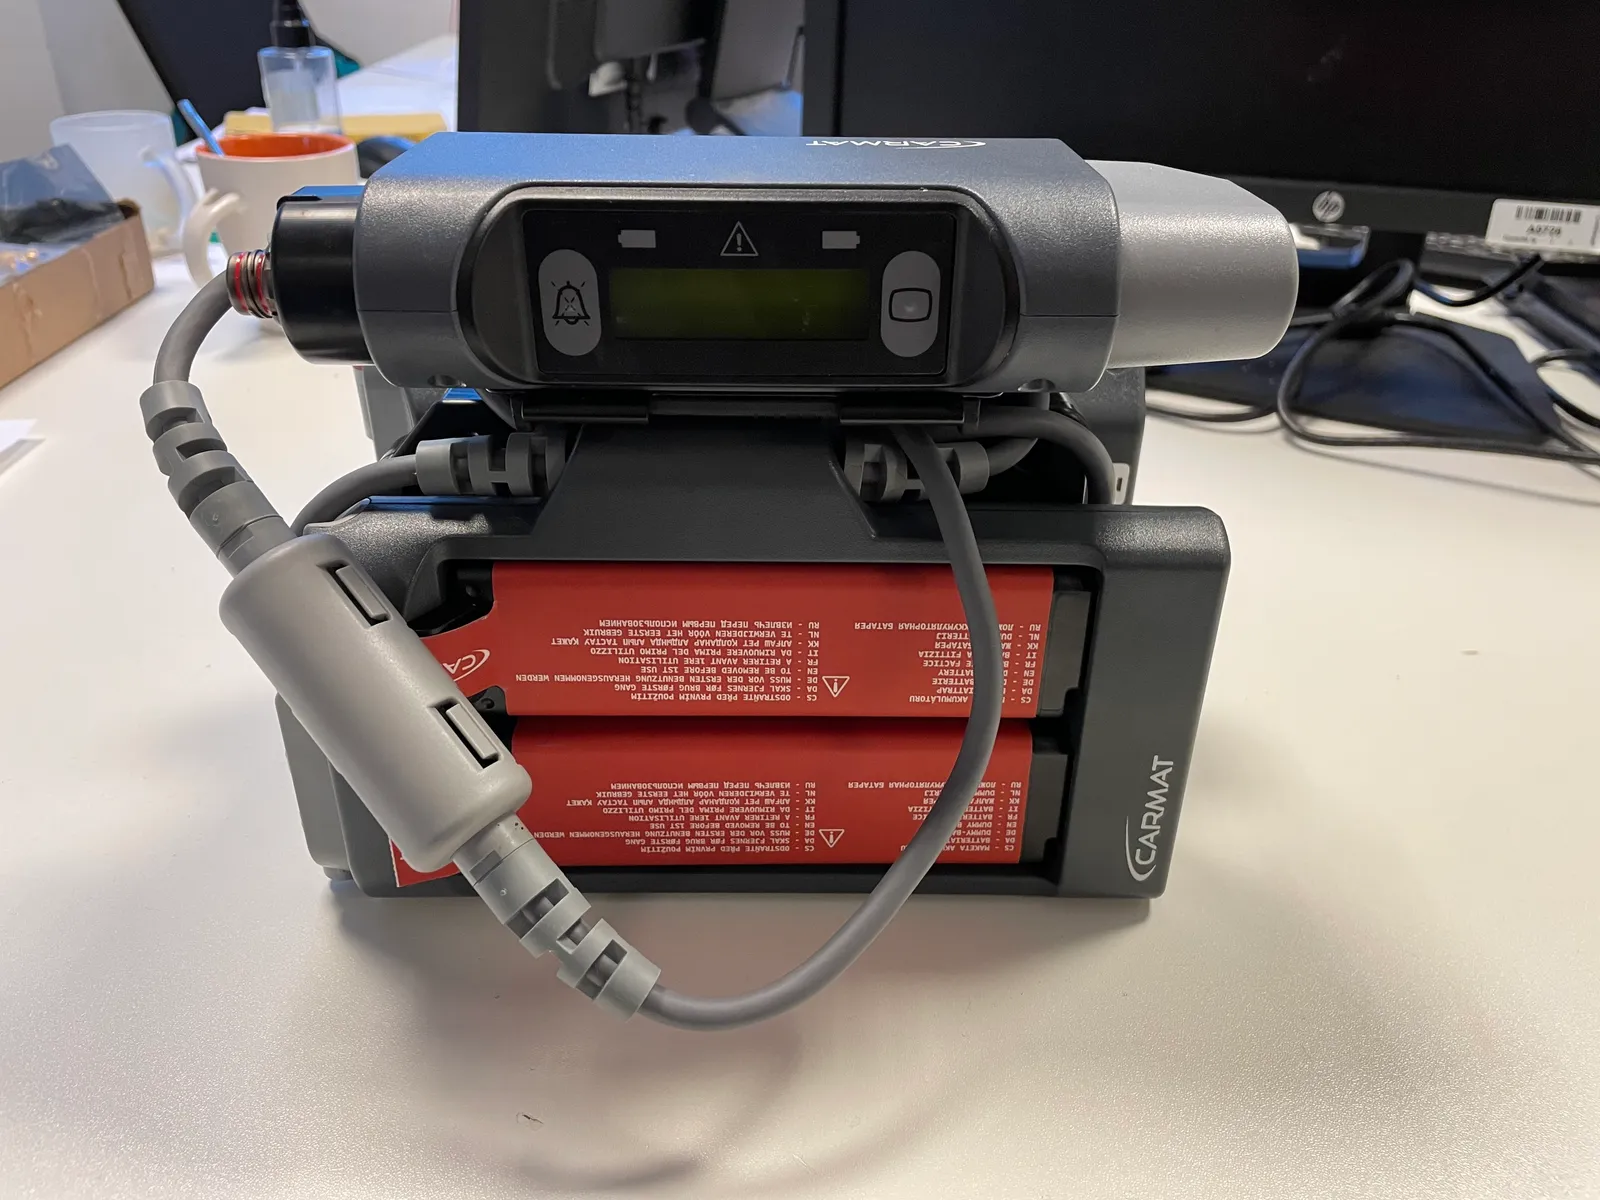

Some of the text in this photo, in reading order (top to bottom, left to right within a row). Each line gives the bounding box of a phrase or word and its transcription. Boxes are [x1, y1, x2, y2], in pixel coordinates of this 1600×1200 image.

[806, 139, 987, 149] CARMAT
[628, 629, 661, 637] EERSTE
[716, 630, 776, 638] VERWIJDEREN
[1027, 642, 1038, 650] KK
[694, 648, 721, 656] PRIMA
[684, 657, 705, 665] 1ERE
[641, 666, 657, 674] USE
[663, 666, 678, 674] 1ST
[554, 674, 630, 682] HERAUSGENOMMEN
[679, 684, 700, 692] BRUG
[1125, 754, 1174, 882] CARMAT
